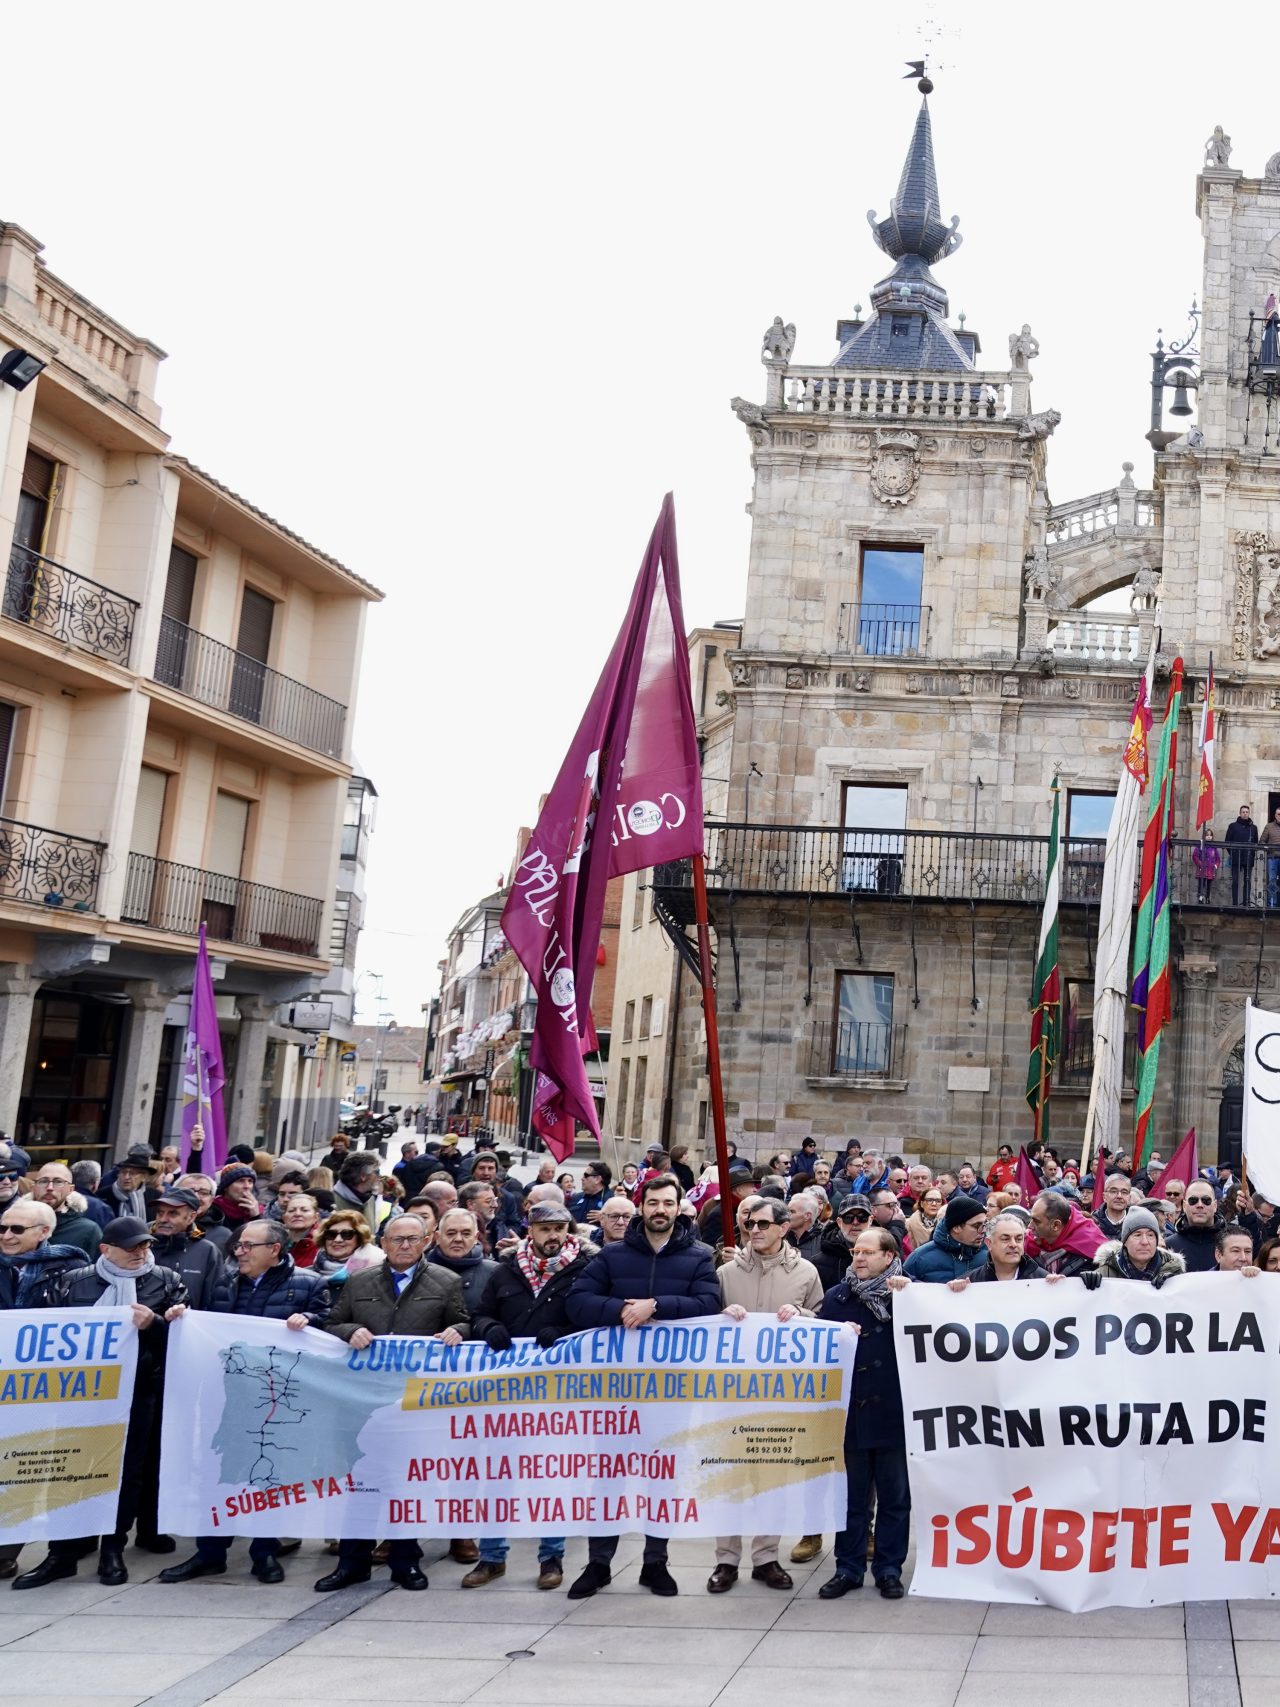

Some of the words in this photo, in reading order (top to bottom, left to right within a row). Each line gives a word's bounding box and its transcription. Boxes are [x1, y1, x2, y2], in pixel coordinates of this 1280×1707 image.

[15, 1320, 122, 1363] OESTE
[591, 1326, 627, 1364] EN
[637, 1327, 707, 1364] TODO
[717, 1327, 743, 1364] EL
[756, 1327, 840, 1364] OESTE
[904, 1316, 1079, 1363] TODOS
[1095, 1313, 1195, 1355] POR
[1208, 1312, 1265, 1353] LA
[59, 1371, 85, 1399] YA
[430, 1378, 547, 1406] RECUPERAR
[554, 1374, 601, 1401] TREN
[608, 1373, 658, 1399] RUTA
[664, 1373, 688, 1399] DE
[694, 1373, 717, 1399] LA
[723, 1373, 785, 1399] PLATA
[792, 1373, 815, 1399] YA
[450, 1414, 478, 1440] LA
[483, 1405, 641, 1438] MARAGATERÍA
[740, 1425, 765, 1433] Quieres
[913, 1405, 1045, 1452] TREN
[1059, 1402, 1194, 1447] RUTA
[1208, 1398, 1267, 1443] DE
[407, 1456, 479, 1482] APOYA
[486, 1456, 512, 1480] LA
[518, 1450, 676, 1480] RECUPERACIÓN
[225, 1478, 306, 1519] SÚBETE
[311, 1478, 342, 1499] YA
[389, 1499, 427, 1524] DEL
[434, 1499, 488, 1524] TREN
[498, 1498, 520, 1523] DE
[528, 1498, 566, 1523] VIA
[572, 1497, 597, 1522] DE
[603, 1496, 630, 1521] LA
[636, 1496, 699, 1524] PLATA
[930, 1486, 1192, 1573] ¡SÚBETE
